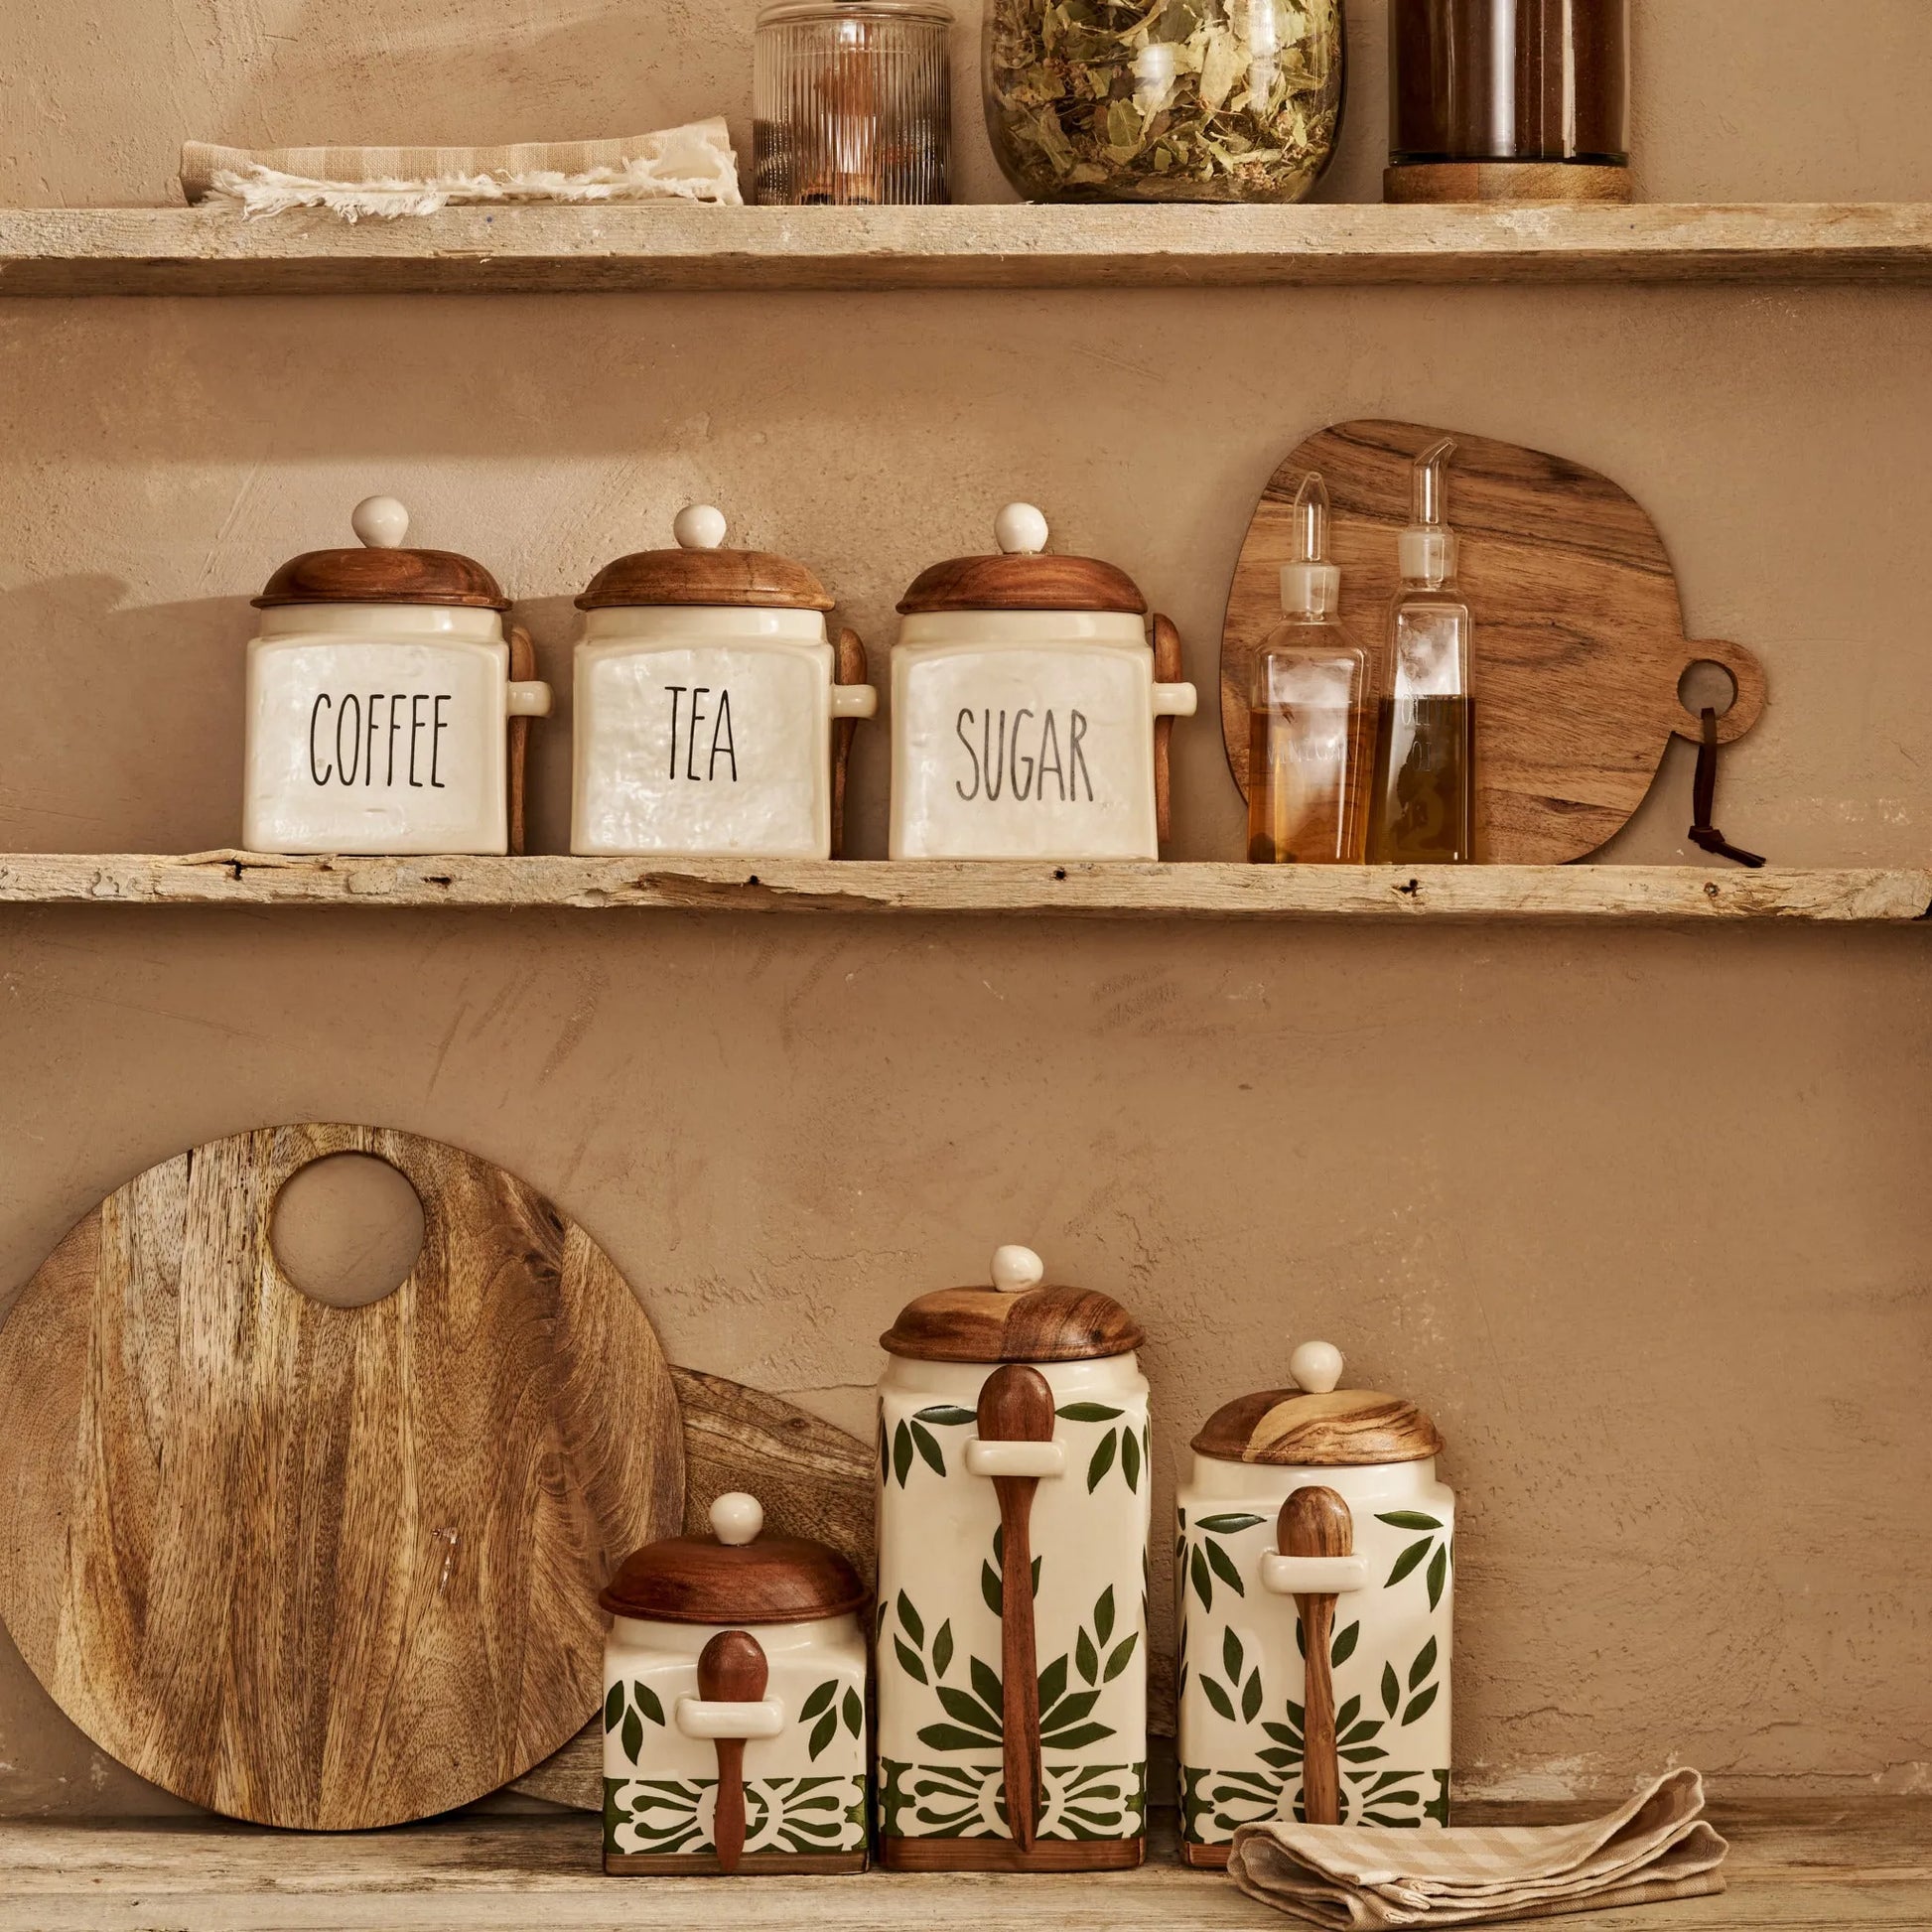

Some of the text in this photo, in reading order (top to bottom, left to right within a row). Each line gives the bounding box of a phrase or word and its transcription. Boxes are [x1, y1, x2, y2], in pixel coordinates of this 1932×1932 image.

[310, 693, 452, 788] COFFEE
[664, 686, 738, 782] TEA
[956, 708, 1094, 802] SUGAR
